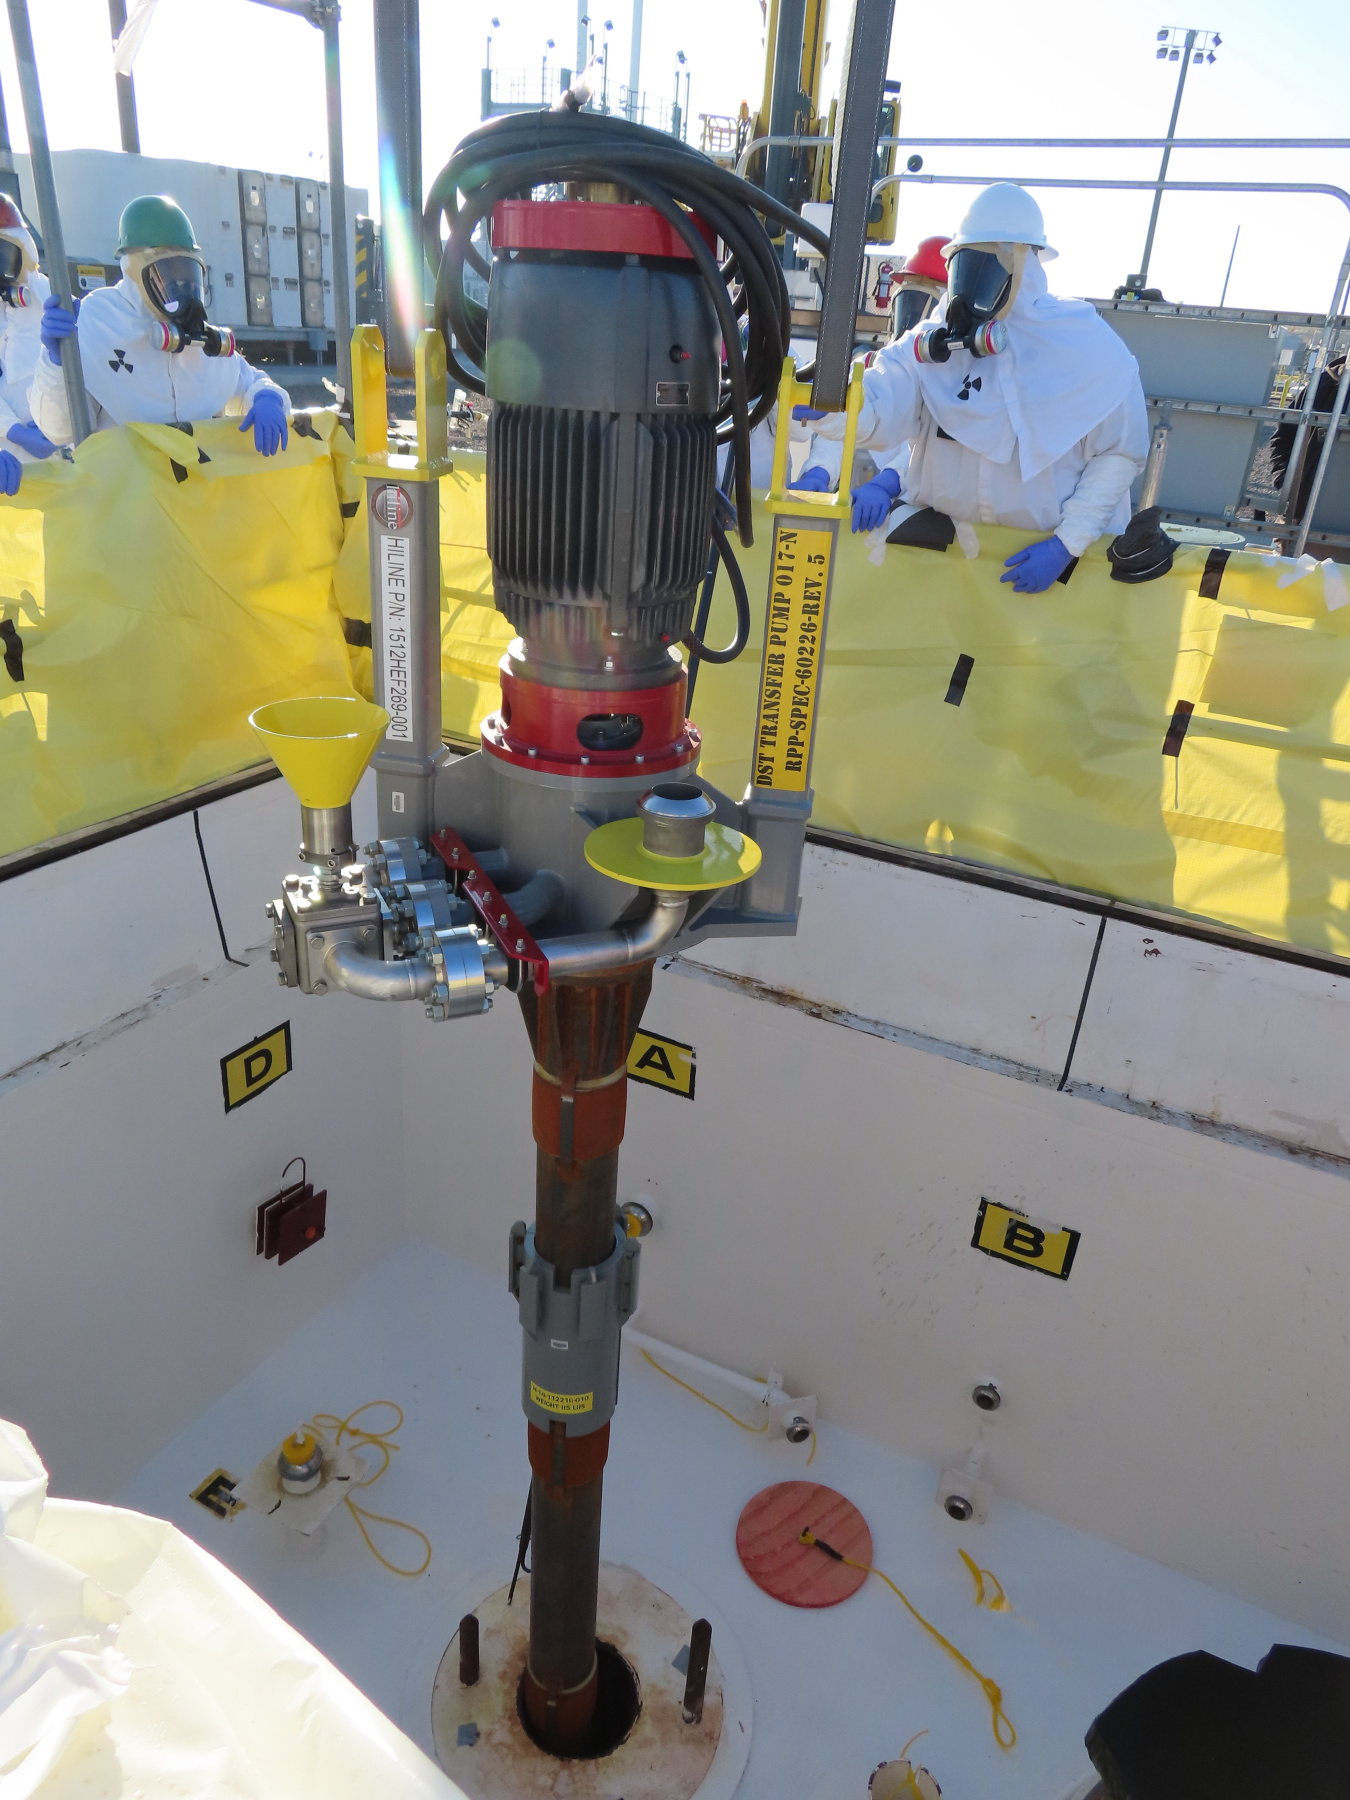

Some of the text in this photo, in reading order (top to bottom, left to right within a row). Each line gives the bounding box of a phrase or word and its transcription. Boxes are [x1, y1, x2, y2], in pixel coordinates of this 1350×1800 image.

[387, 537, 408, 739] HILINE P/N: 1512HEF269-001
[769, 591, 791, 648] PUMP
[760, 652, 786, 748] TRANSFER
[756, 752, 775, 787] DST
[243, 1047, 273, 1088] D
[634, 1044, 676, 1081] A
[1003, 1217, 1045, 1258] B
[535, 1395, 560, 1409] WEIGHT
